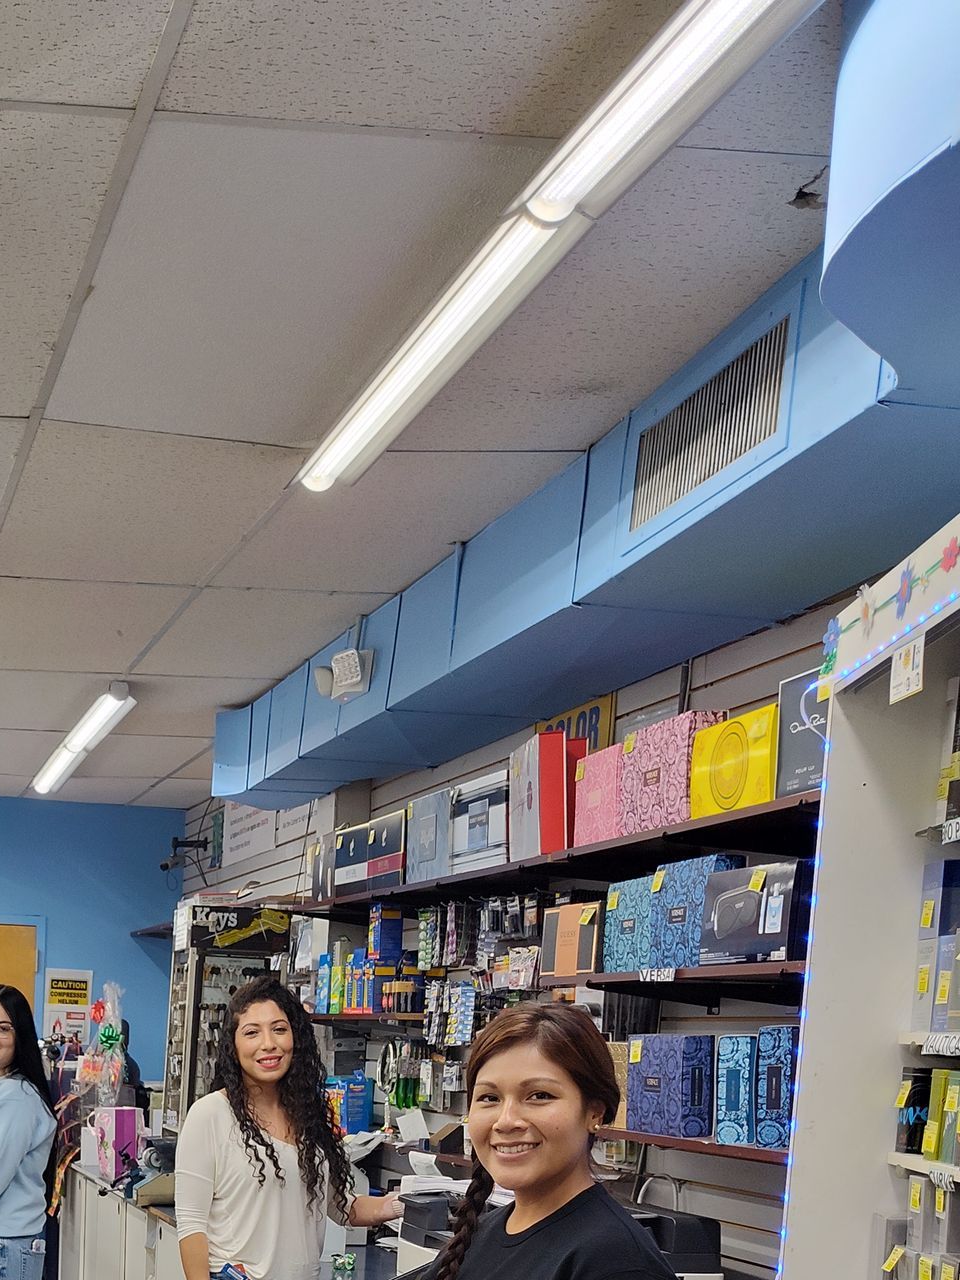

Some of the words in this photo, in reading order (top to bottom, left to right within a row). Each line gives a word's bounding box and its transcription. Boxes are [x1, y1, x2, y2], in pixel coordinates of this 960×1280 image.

[194, 906, 238, 931] Keys
[51, 980, 87, 990] CAUTION
[50, 991, 88, 999] COMPRESSED
